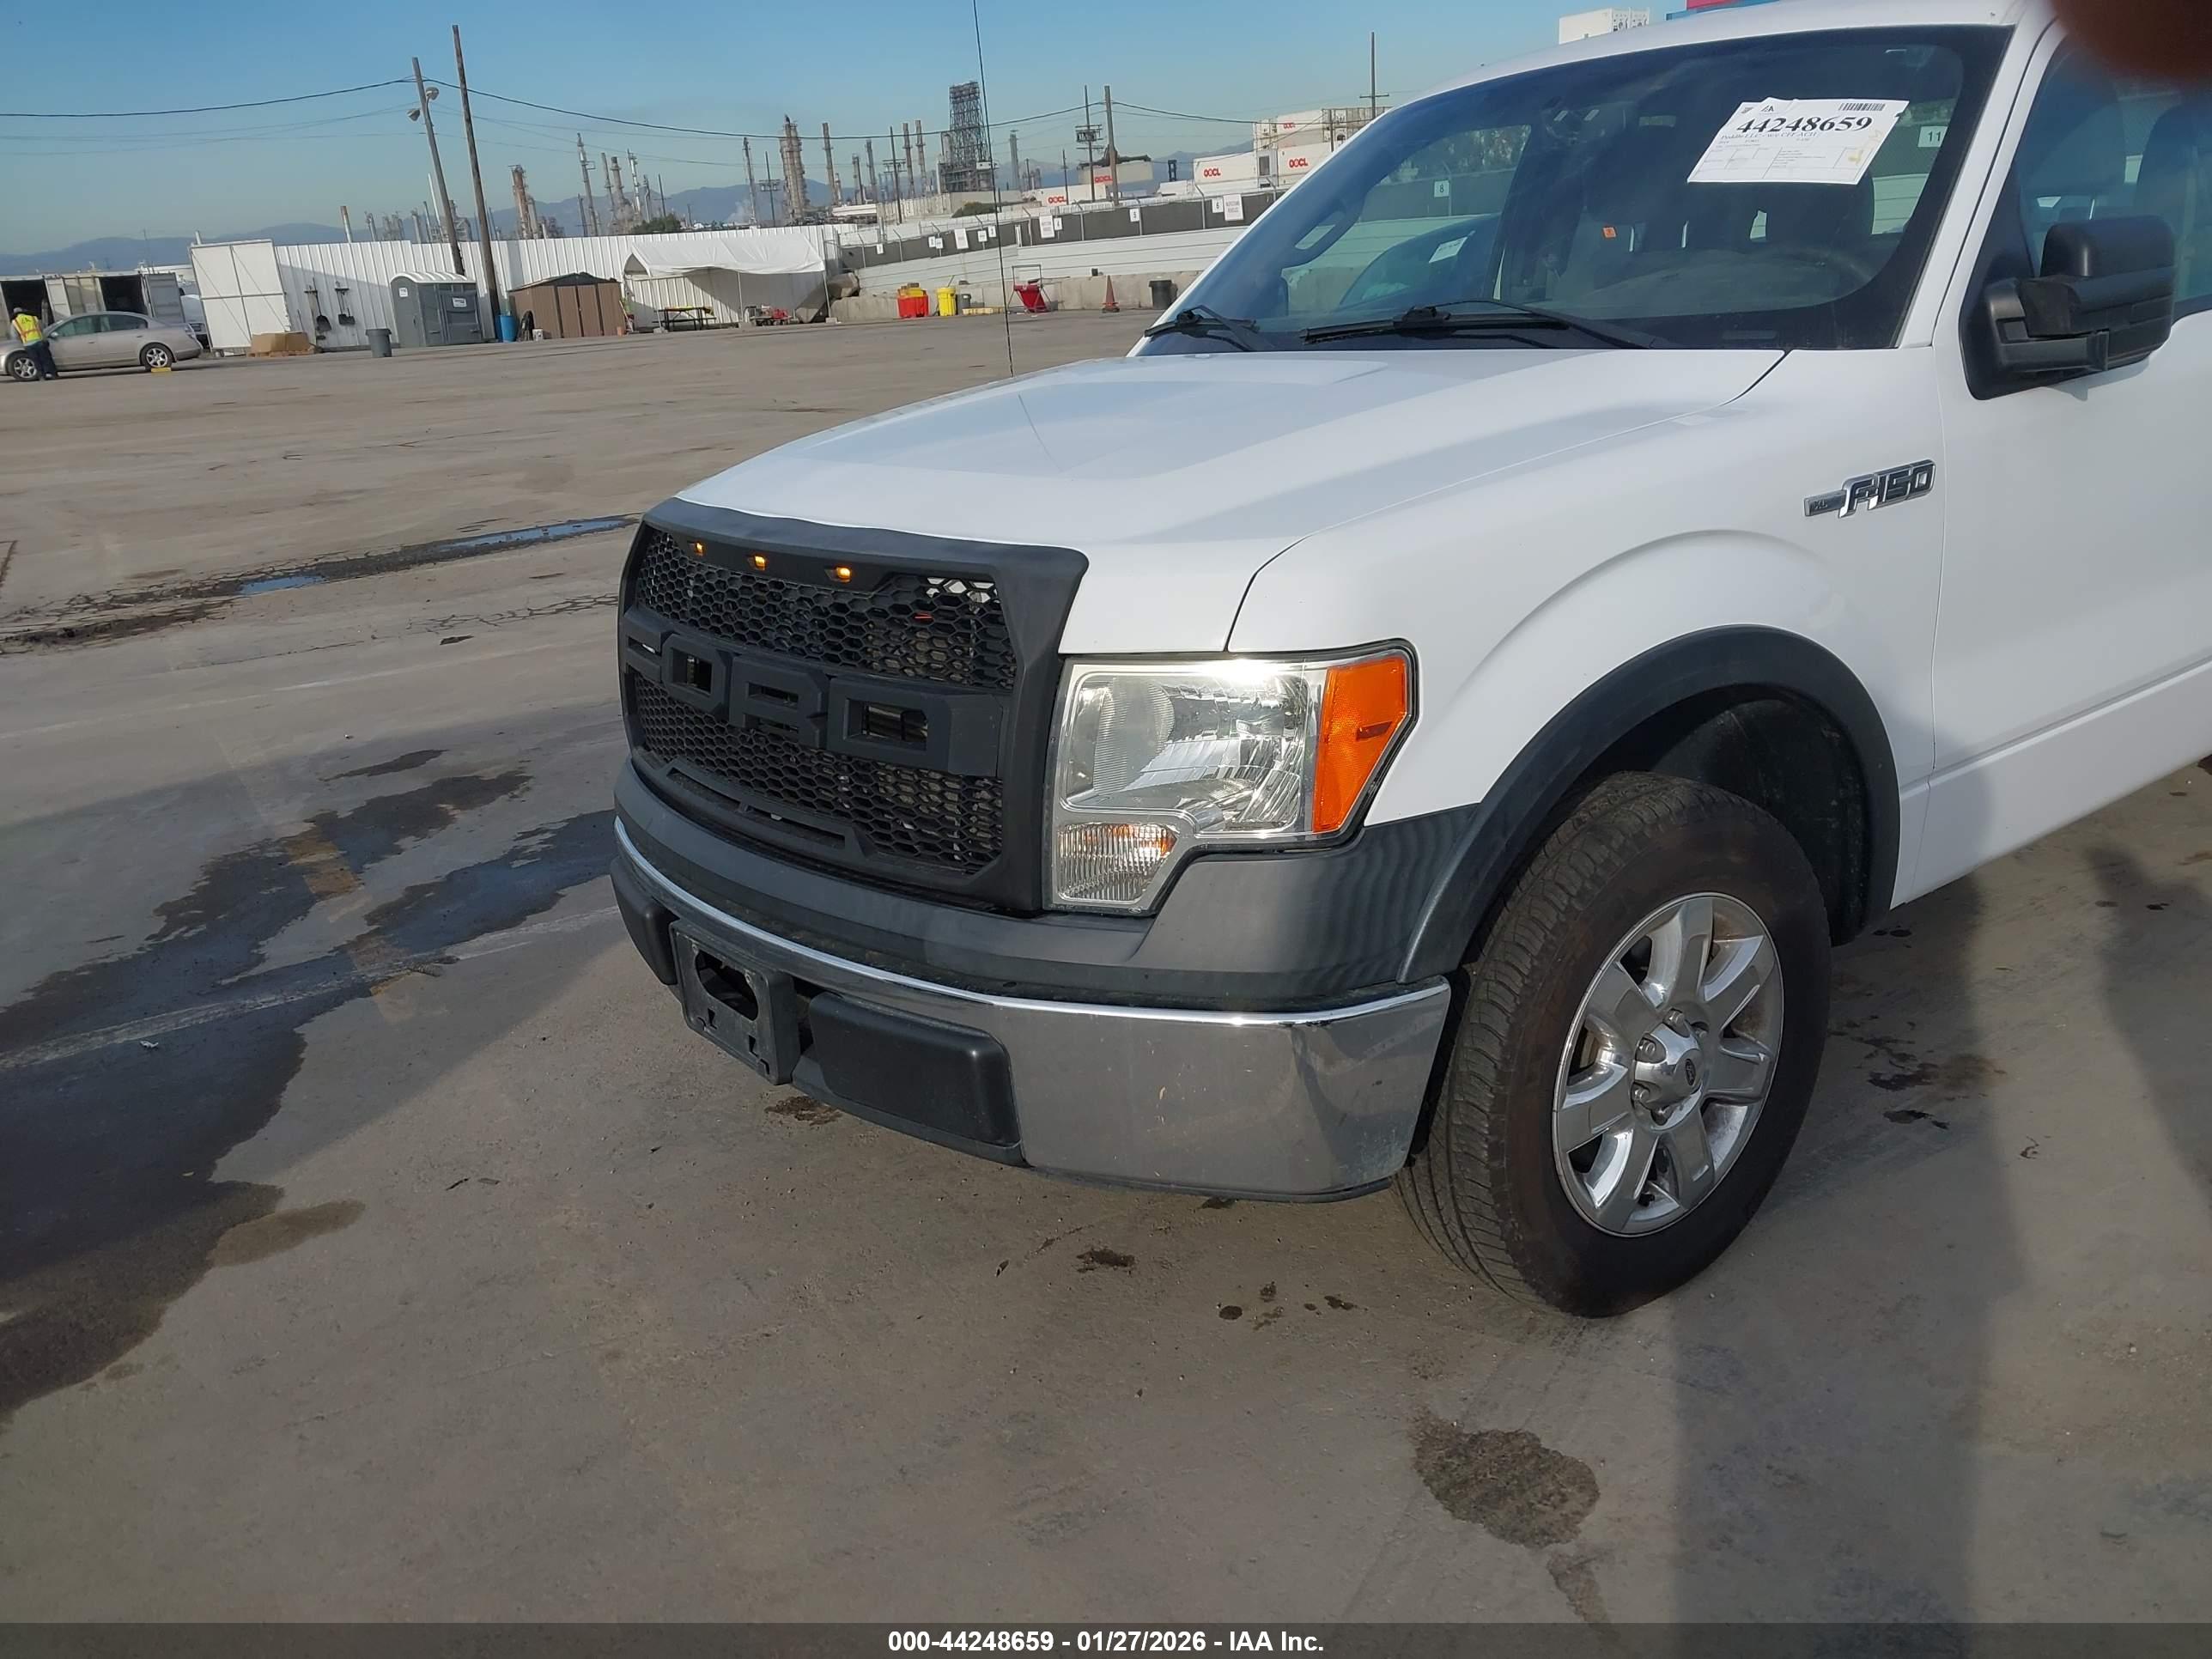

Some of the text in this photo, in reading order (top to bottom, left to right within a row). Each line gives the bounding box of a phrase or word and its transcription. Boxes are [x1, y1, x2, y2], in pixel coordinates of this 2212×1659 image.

[1737, 117, 1873, 133] 44248659
[1928, 131, 1942, 142] 11
[1439, 184, 1444, 193] 8
[618, 606, 951, 775] FORD
